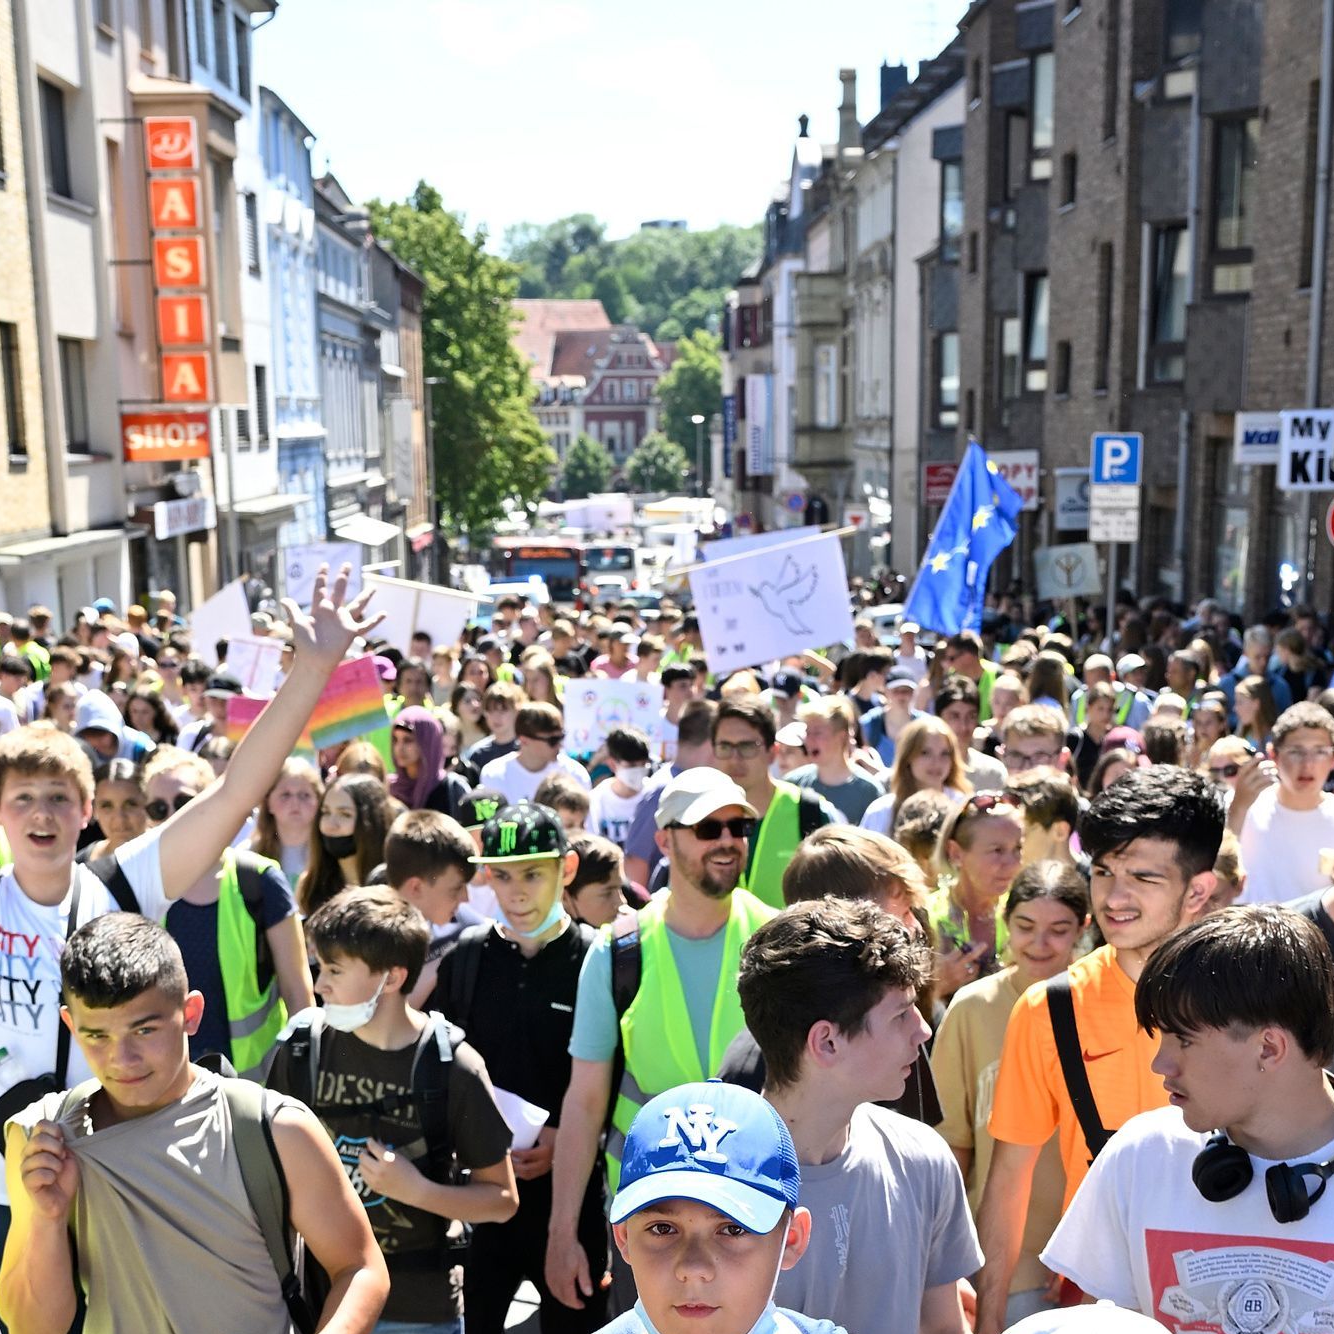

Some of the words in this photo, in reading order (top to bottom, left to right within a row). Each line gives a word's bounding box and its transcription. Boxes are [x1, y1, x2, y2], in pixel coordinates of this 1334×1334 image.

[159, 187, 202, 395] ASIA
[124, 424, 207, 451] SHOP
[1290, 416, 1330, 441] My
[998, 463, 1035, 480] OPY
[1101, 439, 1131, 480] P
[659, 1103, 737, 1165] NY
